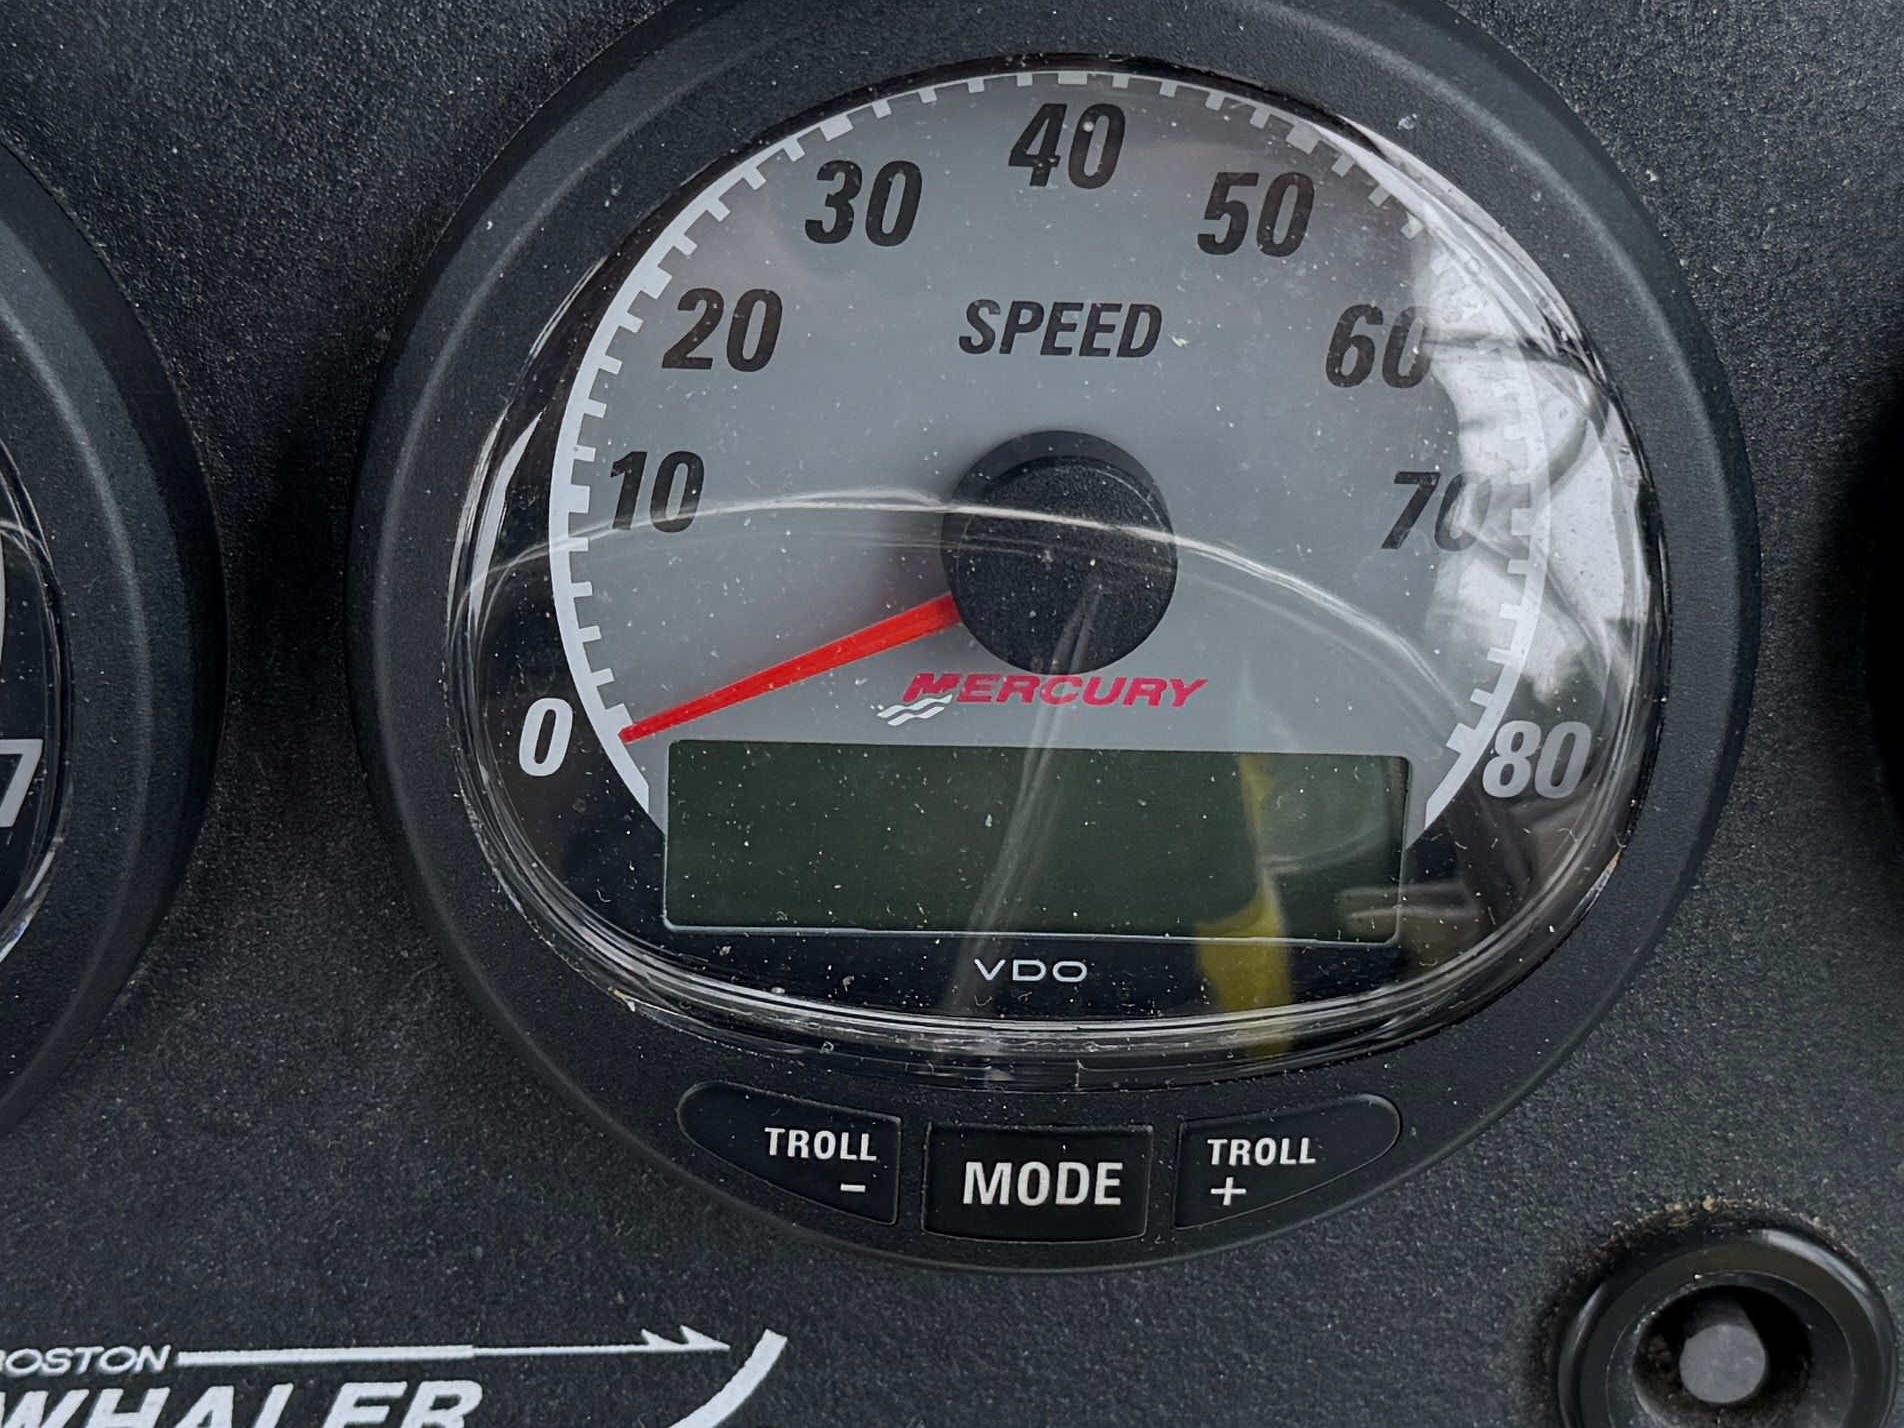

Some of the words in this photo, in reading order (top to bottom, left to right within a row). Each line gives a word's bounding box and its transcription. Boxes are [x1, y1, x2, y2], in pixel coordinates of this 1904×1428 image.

[1009, 102, 1126, 188] 40
[805, 159, 922, 246] 30
[1198, 171, 1315, 257] 50
[663, 288, 783, 372] 20
[959, 300, 1162, 358] SPEED
[1324, 304, 1432, 388] 60
[610, 451, 704, 532] 10
[1381, 471, 1492, 551] 70
[904, 672, 1206, 706] MERCURY
[519, 698, 573, 776] 0
[1482, 720, 1592, 798] 80
[974, 958, 1087, 982] VDO
[765, 1128, 876, 1161] TROLL
[1208, 1138, 1315, 1166] TROLL
[963, 1162, 1122, 1206] MODE
